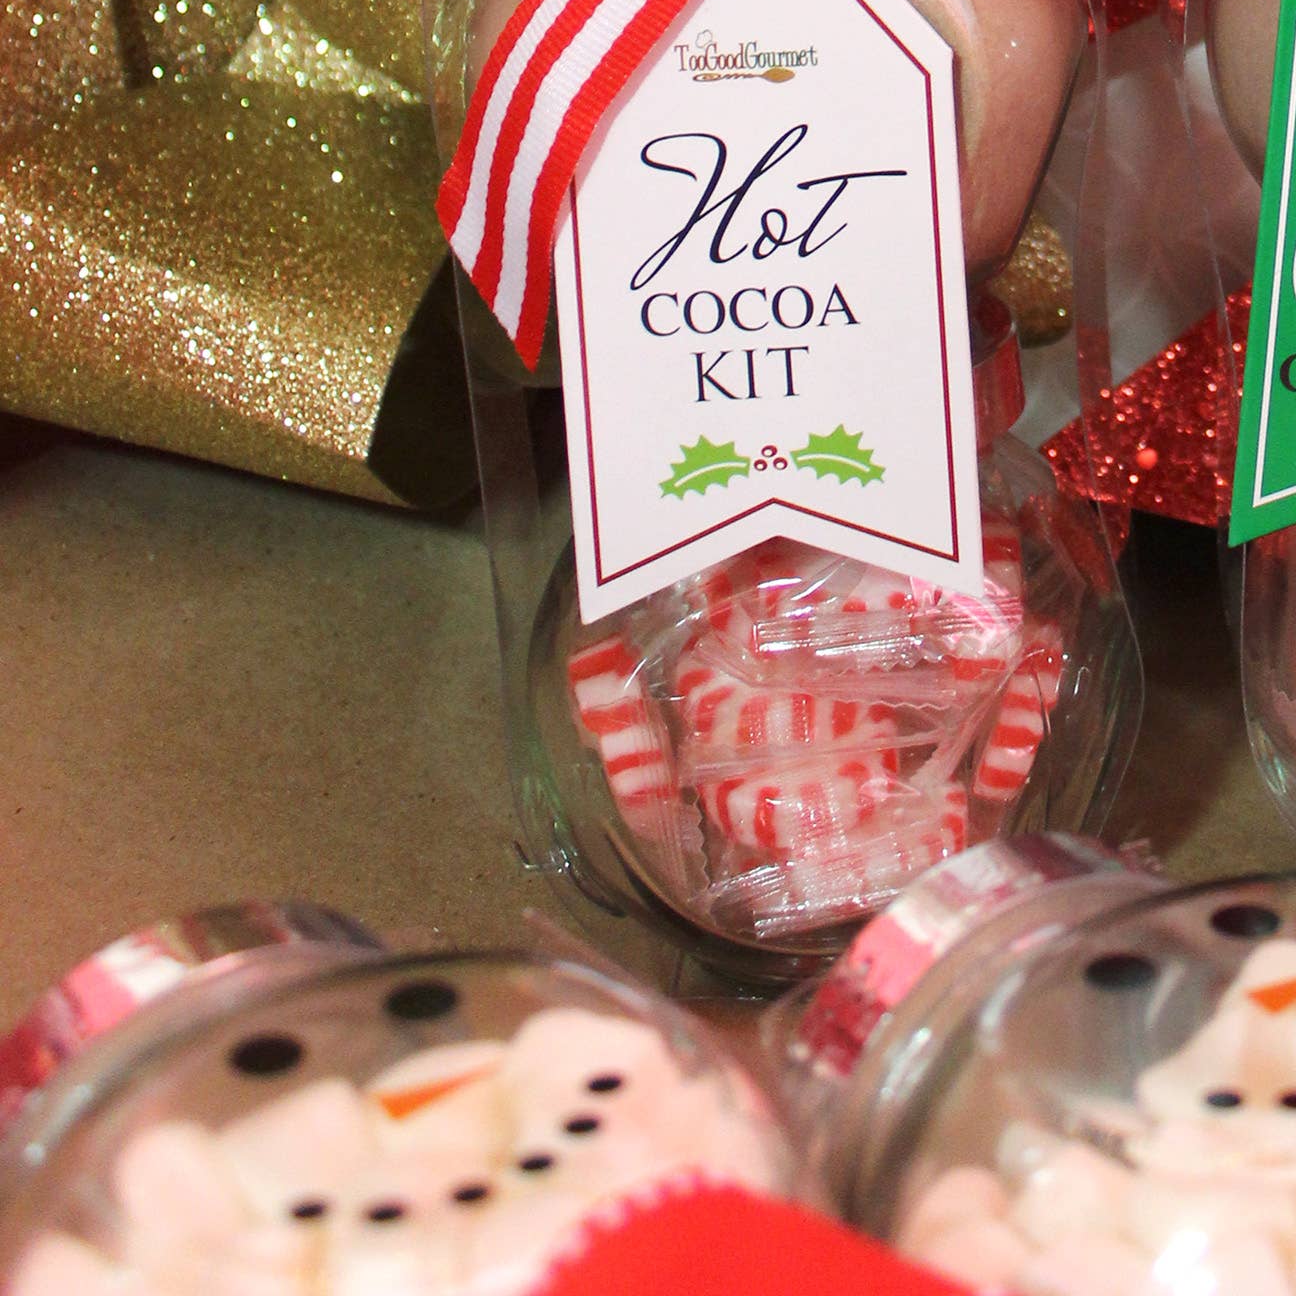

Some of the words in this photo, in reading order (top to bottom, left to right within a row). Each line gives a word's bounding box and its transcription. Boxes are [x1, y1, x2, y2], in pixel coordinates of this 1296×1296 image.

[630, 124, 908, 290] Hot
[640, 283, 860, 336] COCOA
[691, 346, 809, 403] KIT
